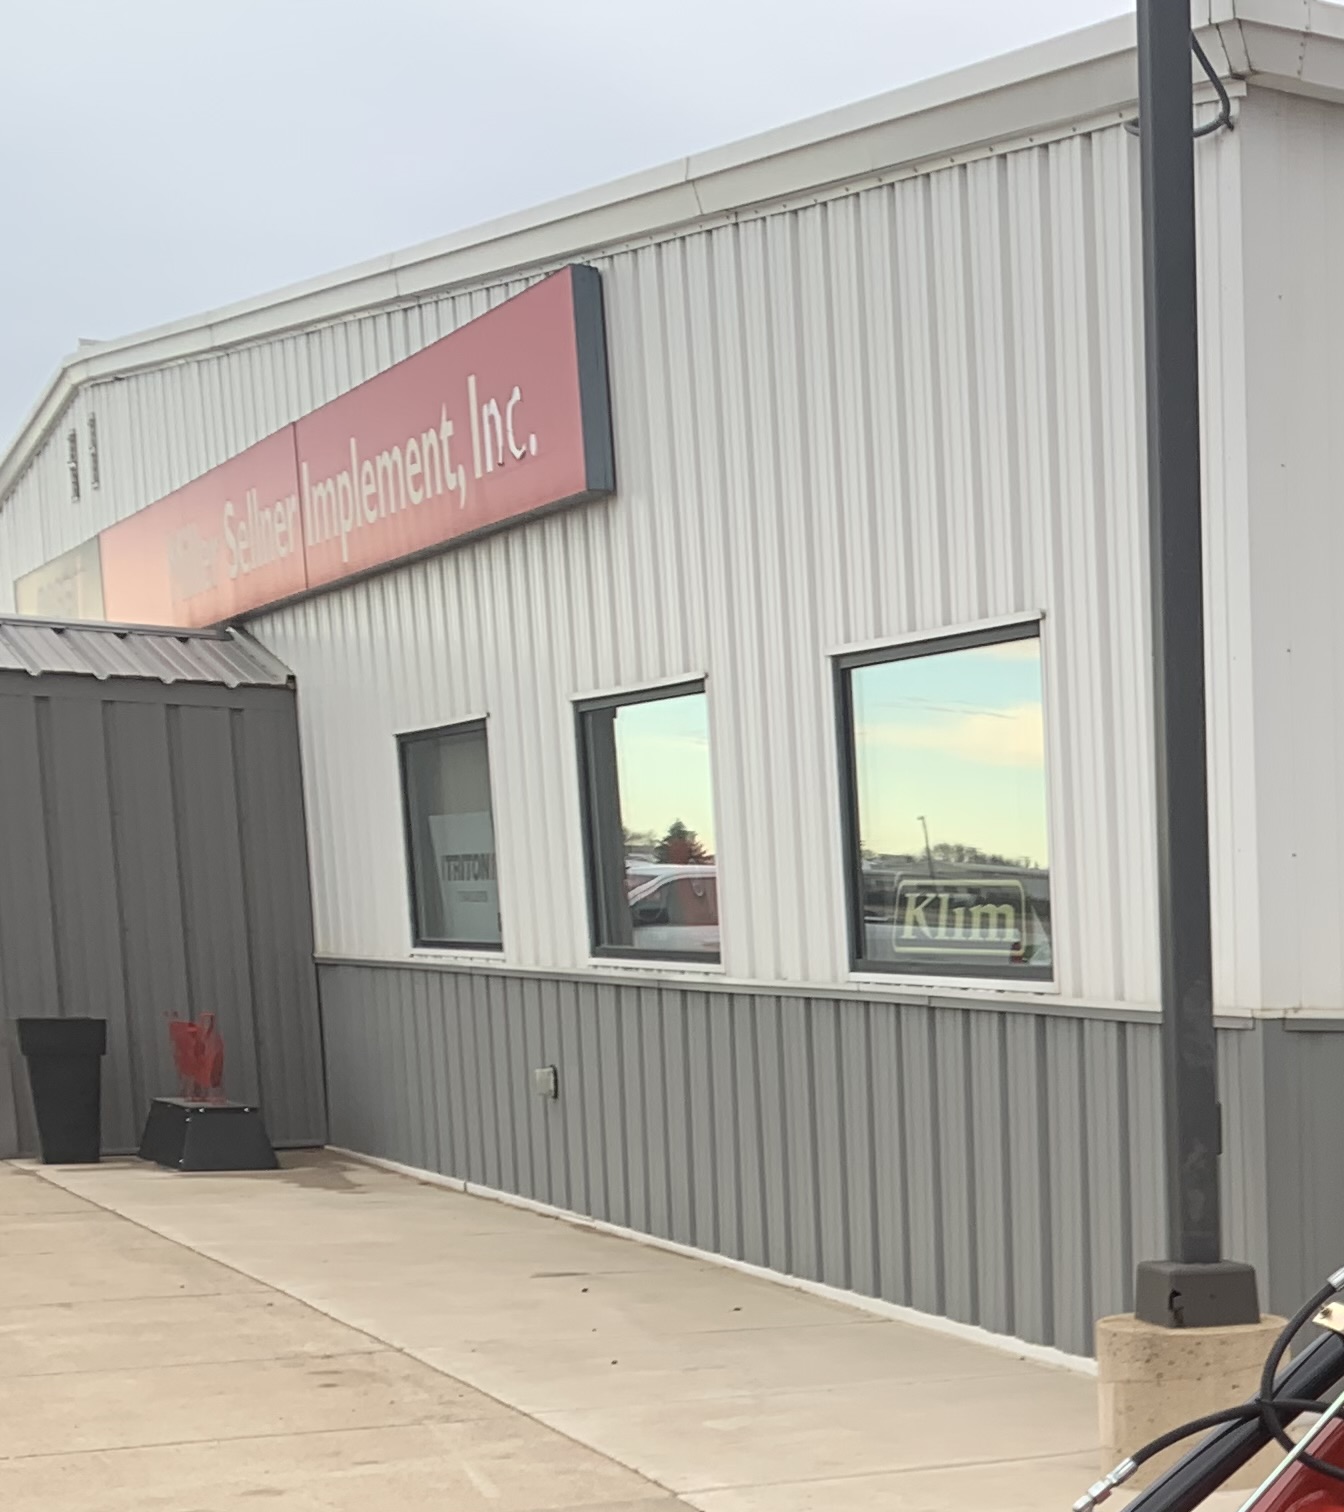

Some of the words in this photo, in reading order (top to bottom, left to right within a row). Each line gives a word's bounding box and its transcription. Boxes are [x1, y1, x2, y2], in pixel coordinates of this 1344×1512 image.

[223, 487, 297, 579] Sellner
[302, 402, 466, 563] Implement,
[467, 374, 538, 479] Inc.
